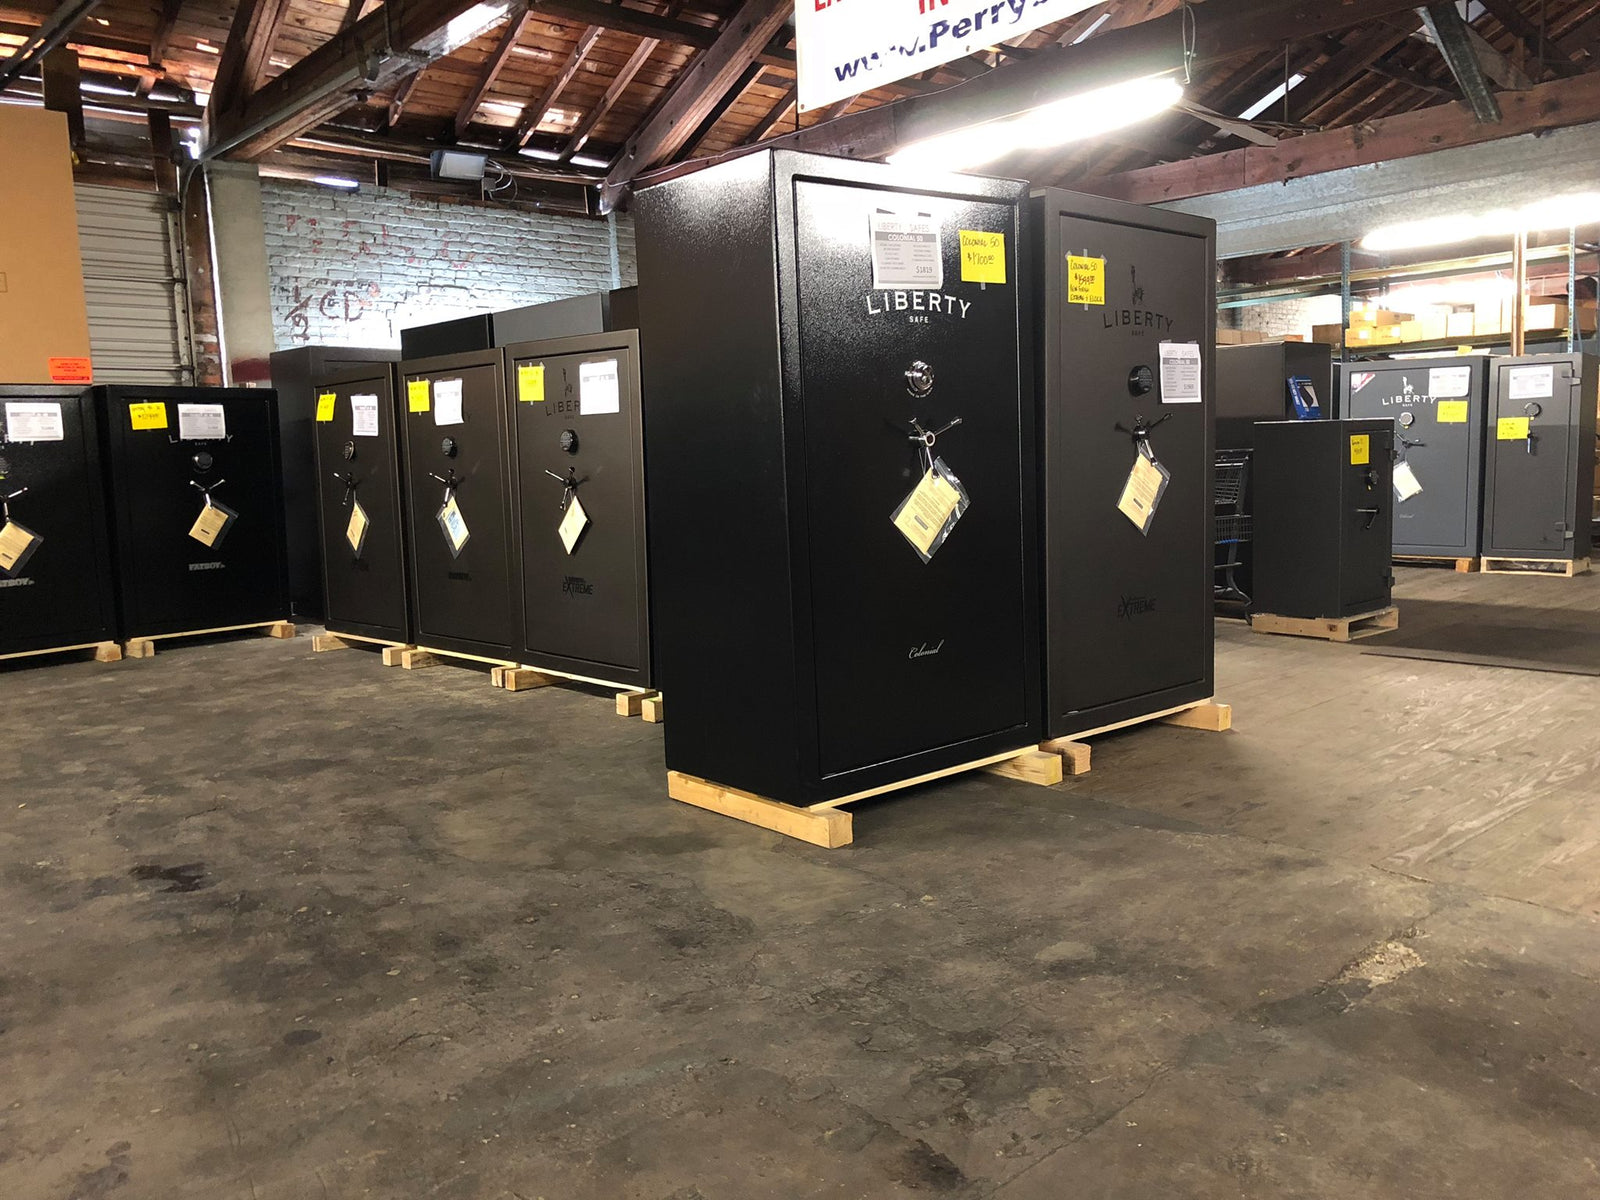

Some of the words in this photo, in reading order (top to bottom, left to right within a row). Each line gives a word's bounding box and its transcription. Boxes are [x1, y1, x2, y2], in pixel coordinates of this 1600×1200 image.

[866, 291, 972, 319] LIBERTY
[1103, 310, 1174, 333] LIBERTY
[545, 400, 580, 416] LIBER
[1382, 395, 1437, 405] LIBERTY
